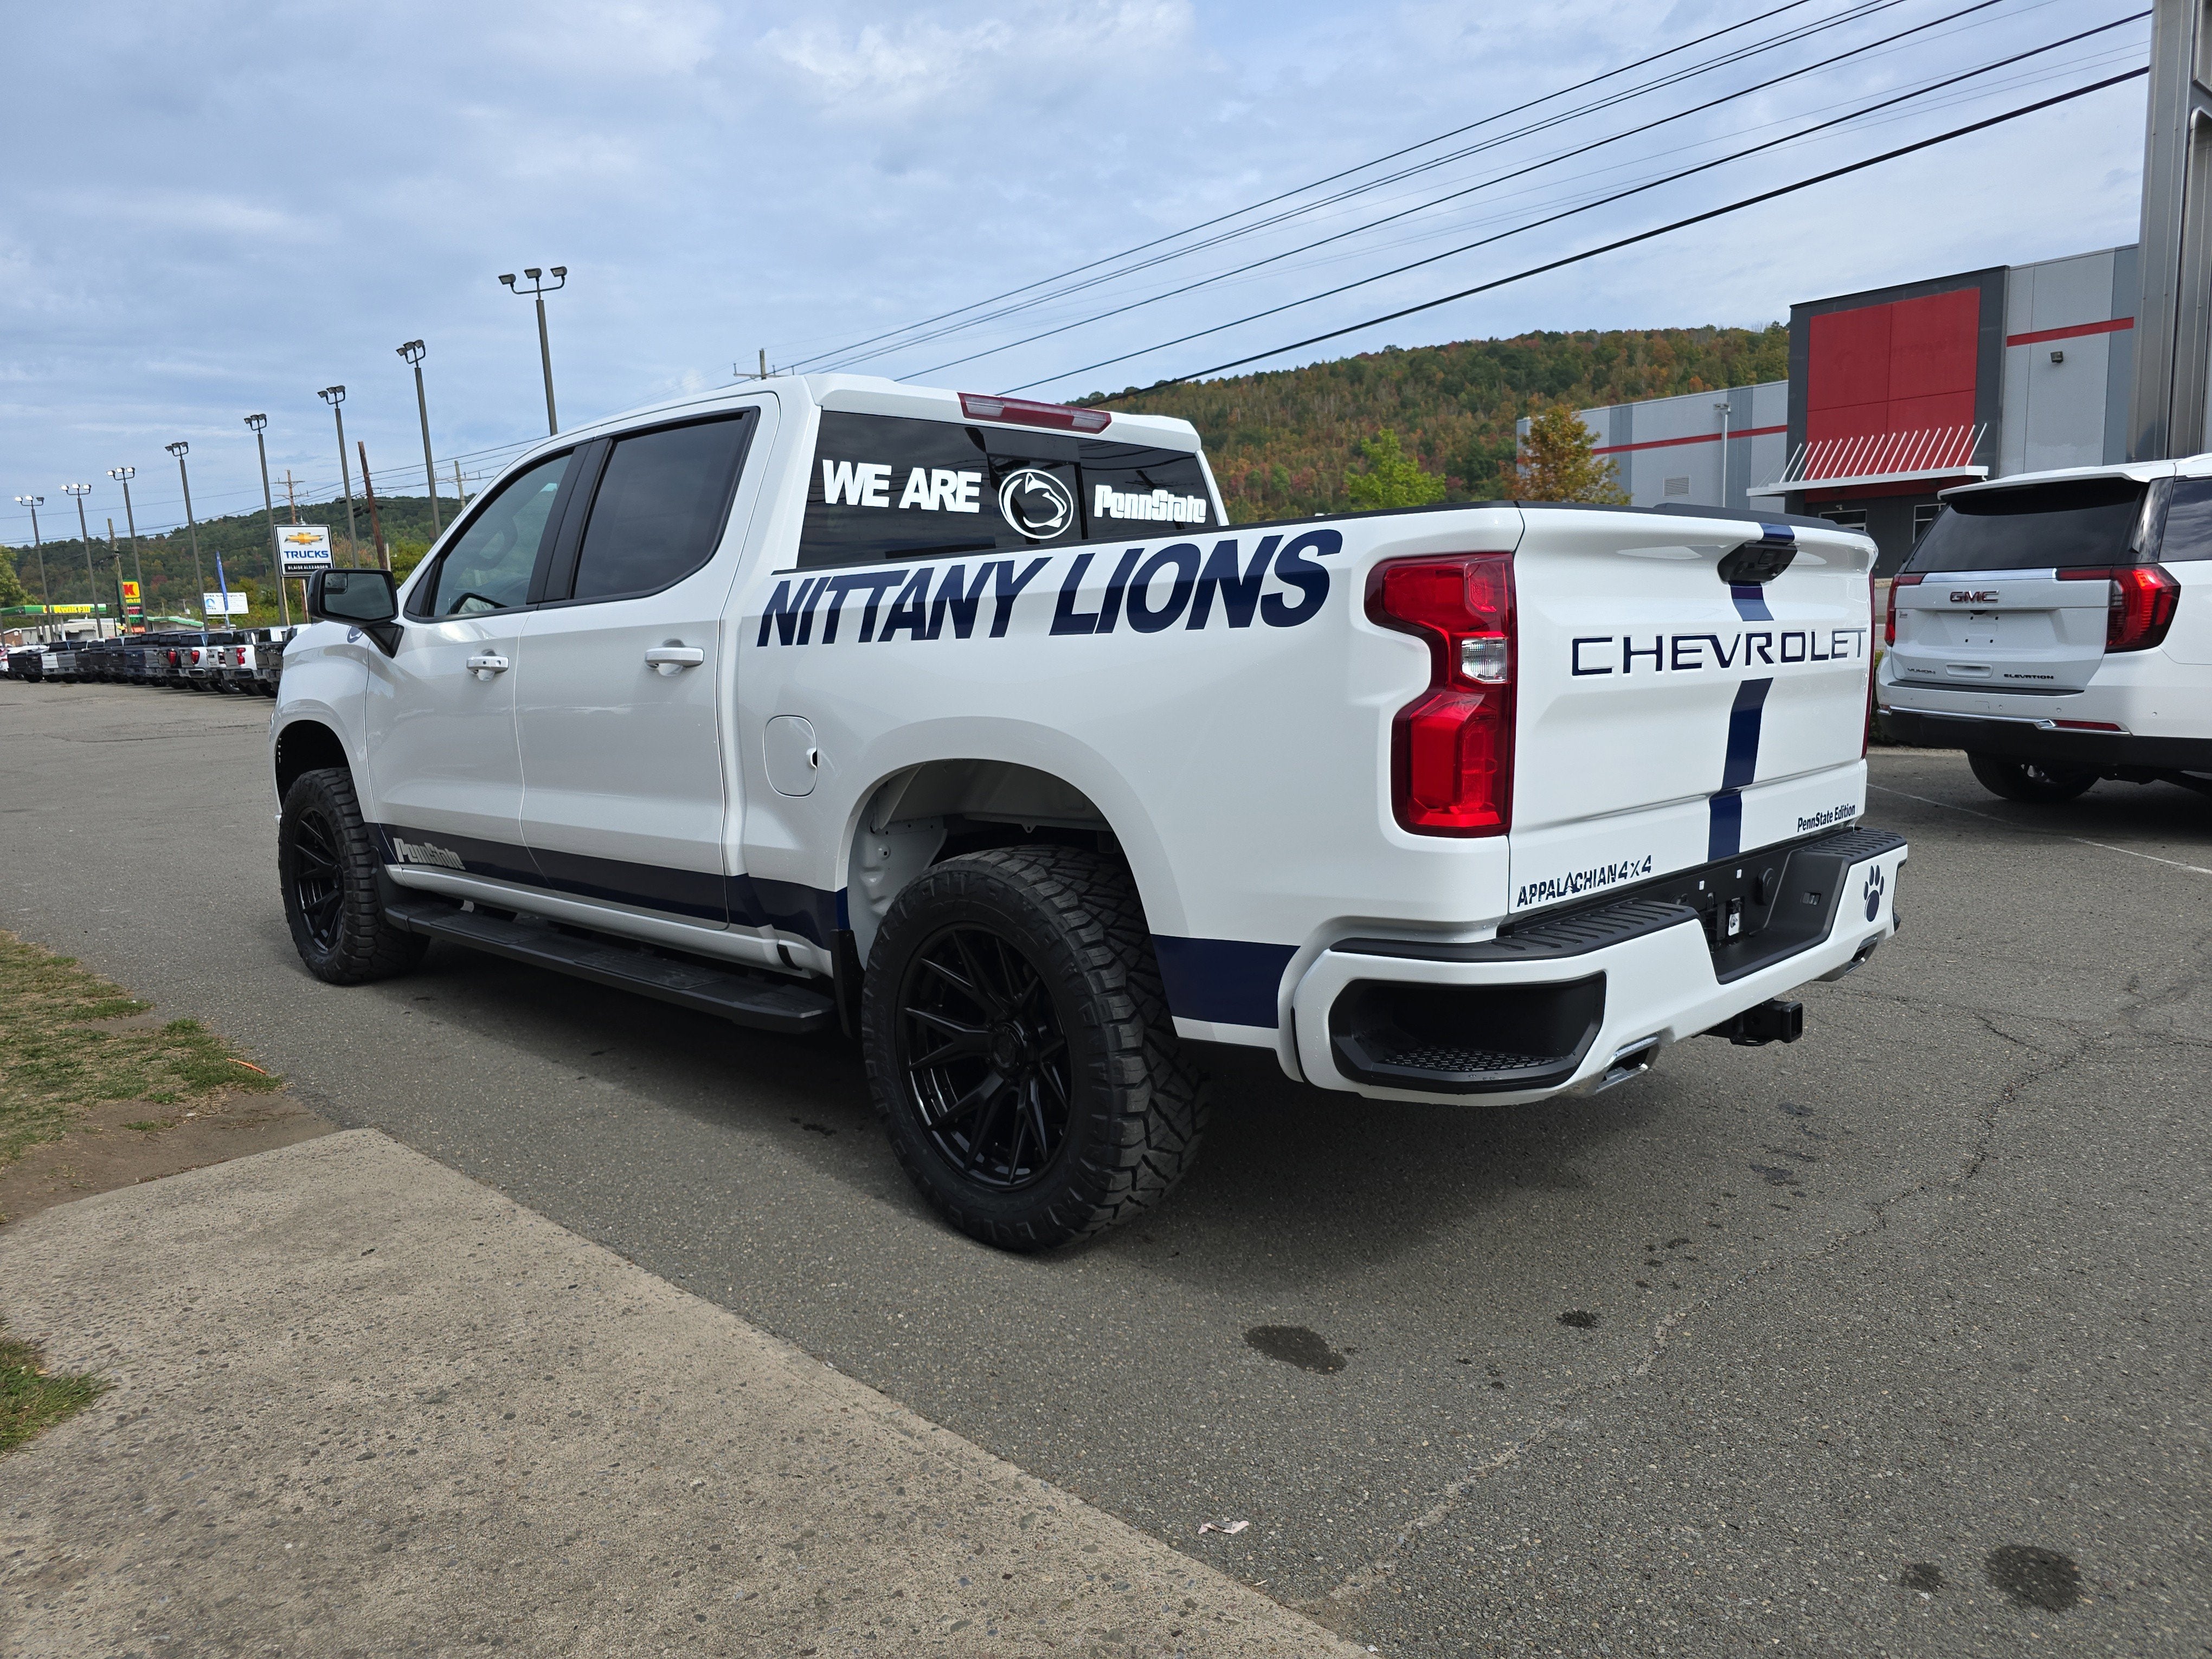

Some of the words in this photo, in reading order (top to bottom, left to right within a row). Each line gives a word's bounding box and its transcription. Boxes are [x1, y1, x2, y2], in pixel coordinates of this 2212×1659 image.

[822, 459, 892, 507] WE
[898, 467, 982, 513] ARE
[1094, 484, 1206, 523] PennState
[284, 550, 329, 559] TRUCKS
[757, 557, 1053, 647] NITTANY
[1049, 529, 1343, 636] LIONS
[1950, 589, 1999, 603] GMC
[1572, 629, 1867, 676] CHEVROLET
[1834, 803, 1855, 821] Edition
